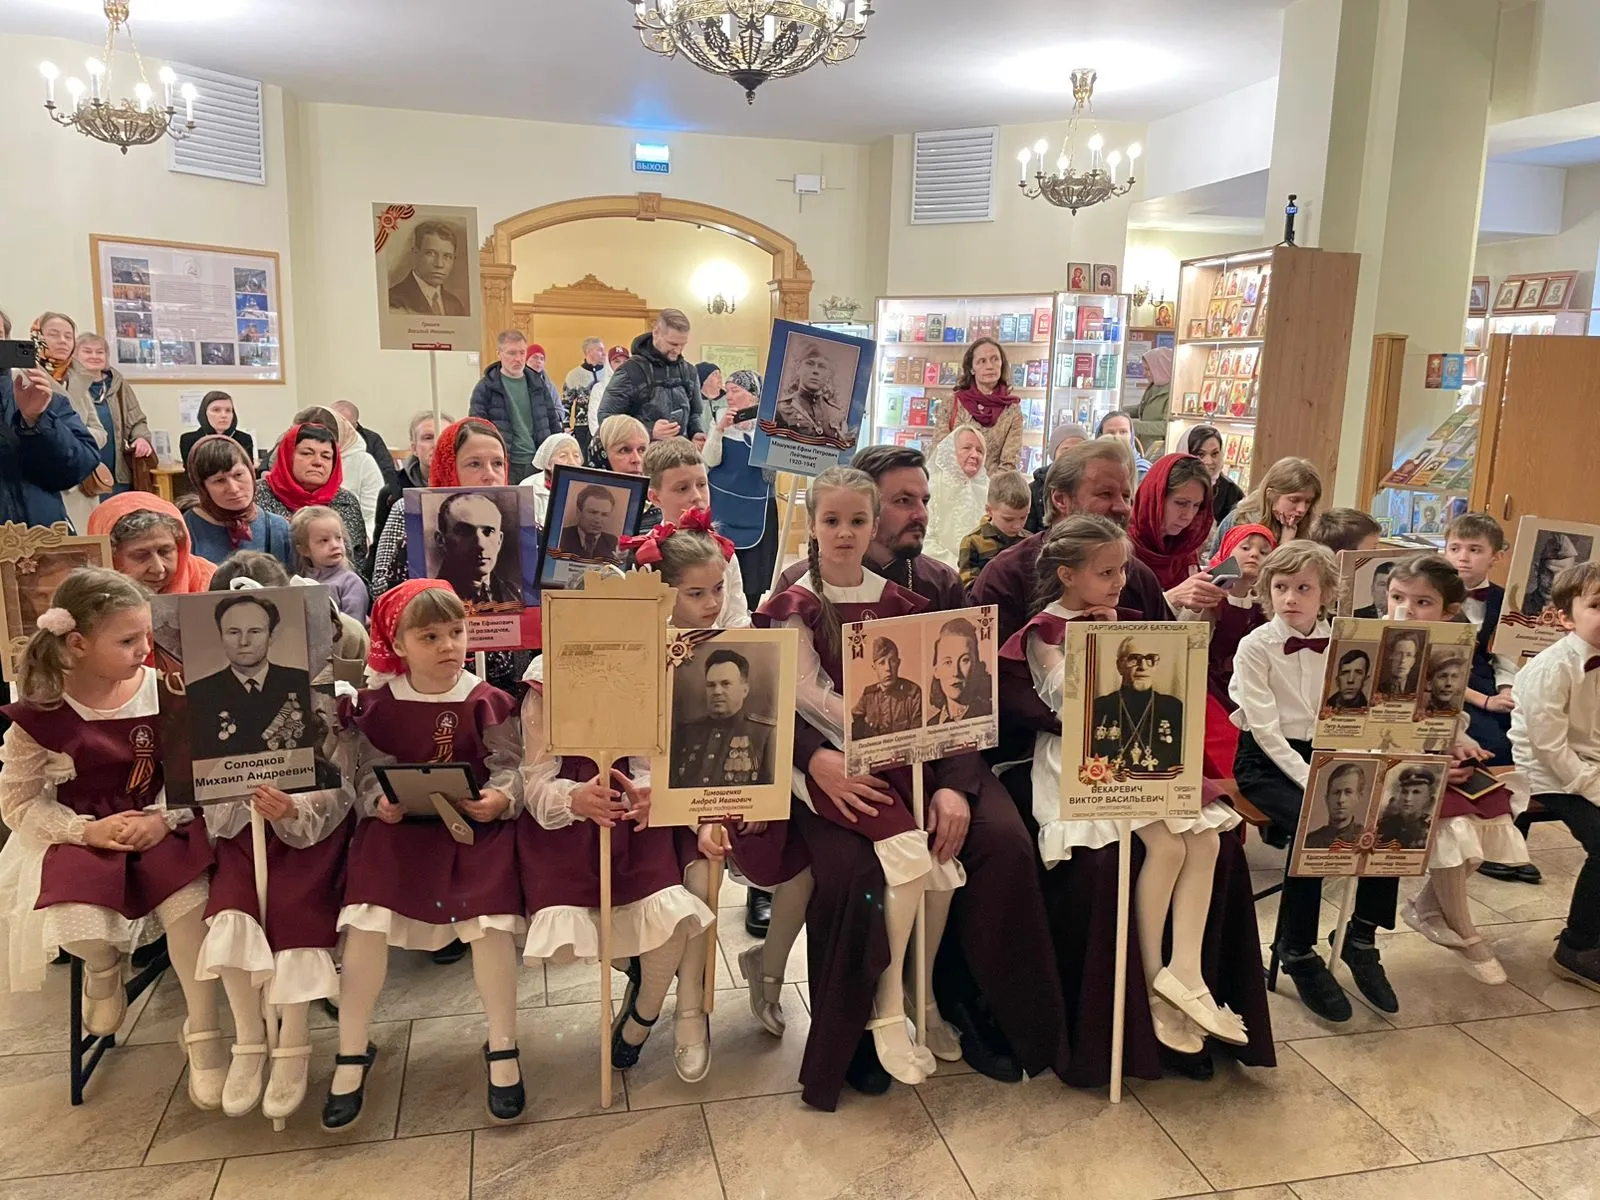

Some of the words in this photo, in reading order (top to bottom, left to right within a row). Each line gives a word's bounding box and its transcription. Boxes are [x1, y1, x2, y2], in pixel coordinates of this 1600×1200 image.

[636, 161, 668, 172] ВЫХОД
[797, 446, 812, 454] Ефим
[812, 449, 838, 459] Петрович
[1088, 623, 1148, 631] ПАРТИЗАНСКИЙ
[224, 756, 285, 771] Солодков
[195, 774, 243, 788] Михаил
[246, 766, 315, 781] Андреевич
[703, 789, 742, 797] Тимошенко
[1091, 786, 1143, 794] БЕКАРЕВИЧ
[691, 797, 717, 806] Андрей
[719, 796, 752, 804] Иванович
[1069, 796, 1104, 805] ВИКТОР
[1106, 795, 1165, 804] ВАСИЛЬЕВИЧ
